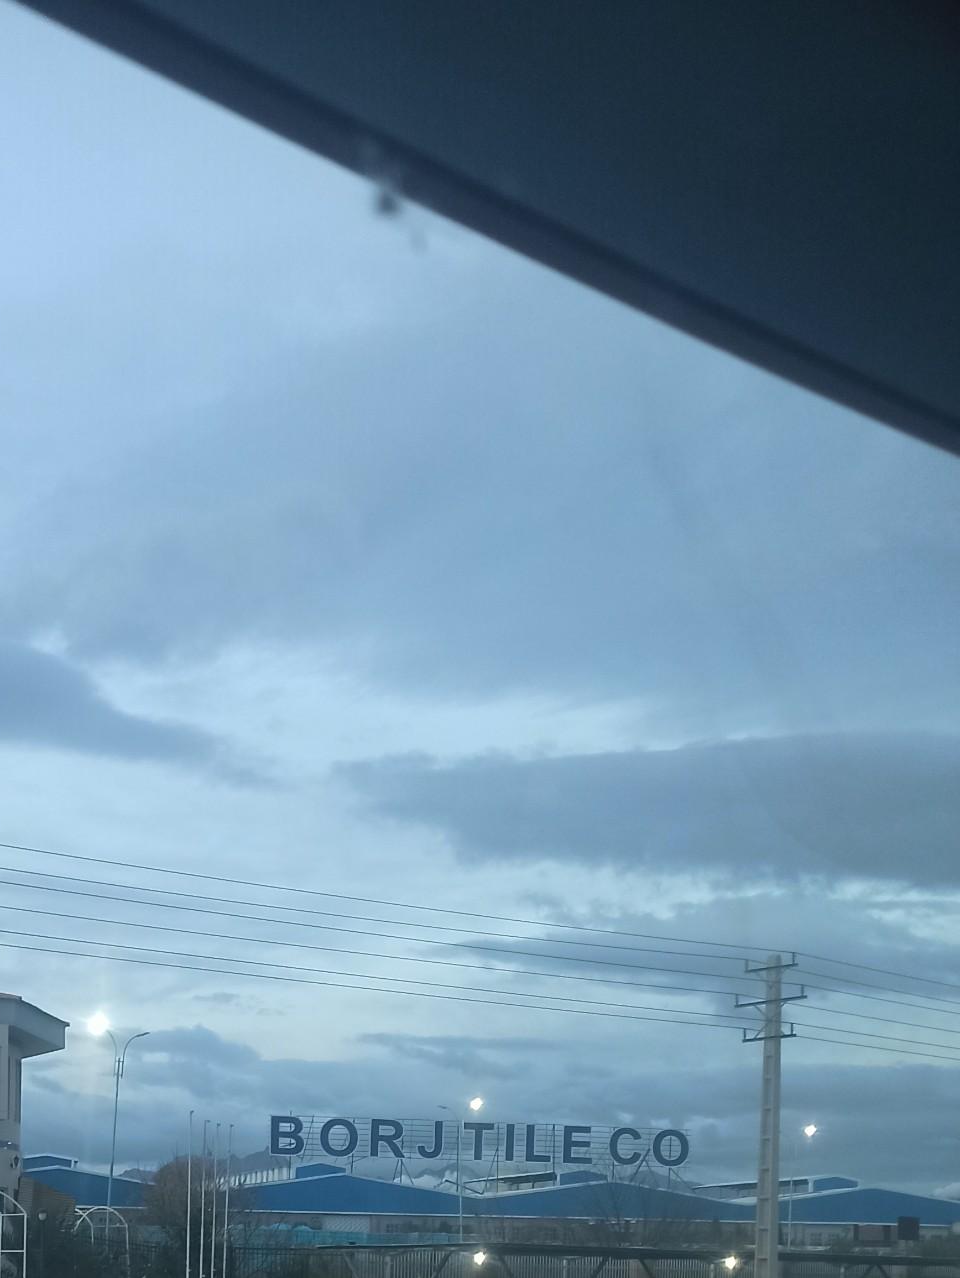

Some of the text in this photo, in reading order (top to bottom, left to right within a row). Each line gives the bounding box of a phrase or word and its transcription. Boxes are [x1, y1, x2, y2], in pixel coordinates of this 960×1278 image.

[269, 1115, 690, 1167] BORJ TILE CO
